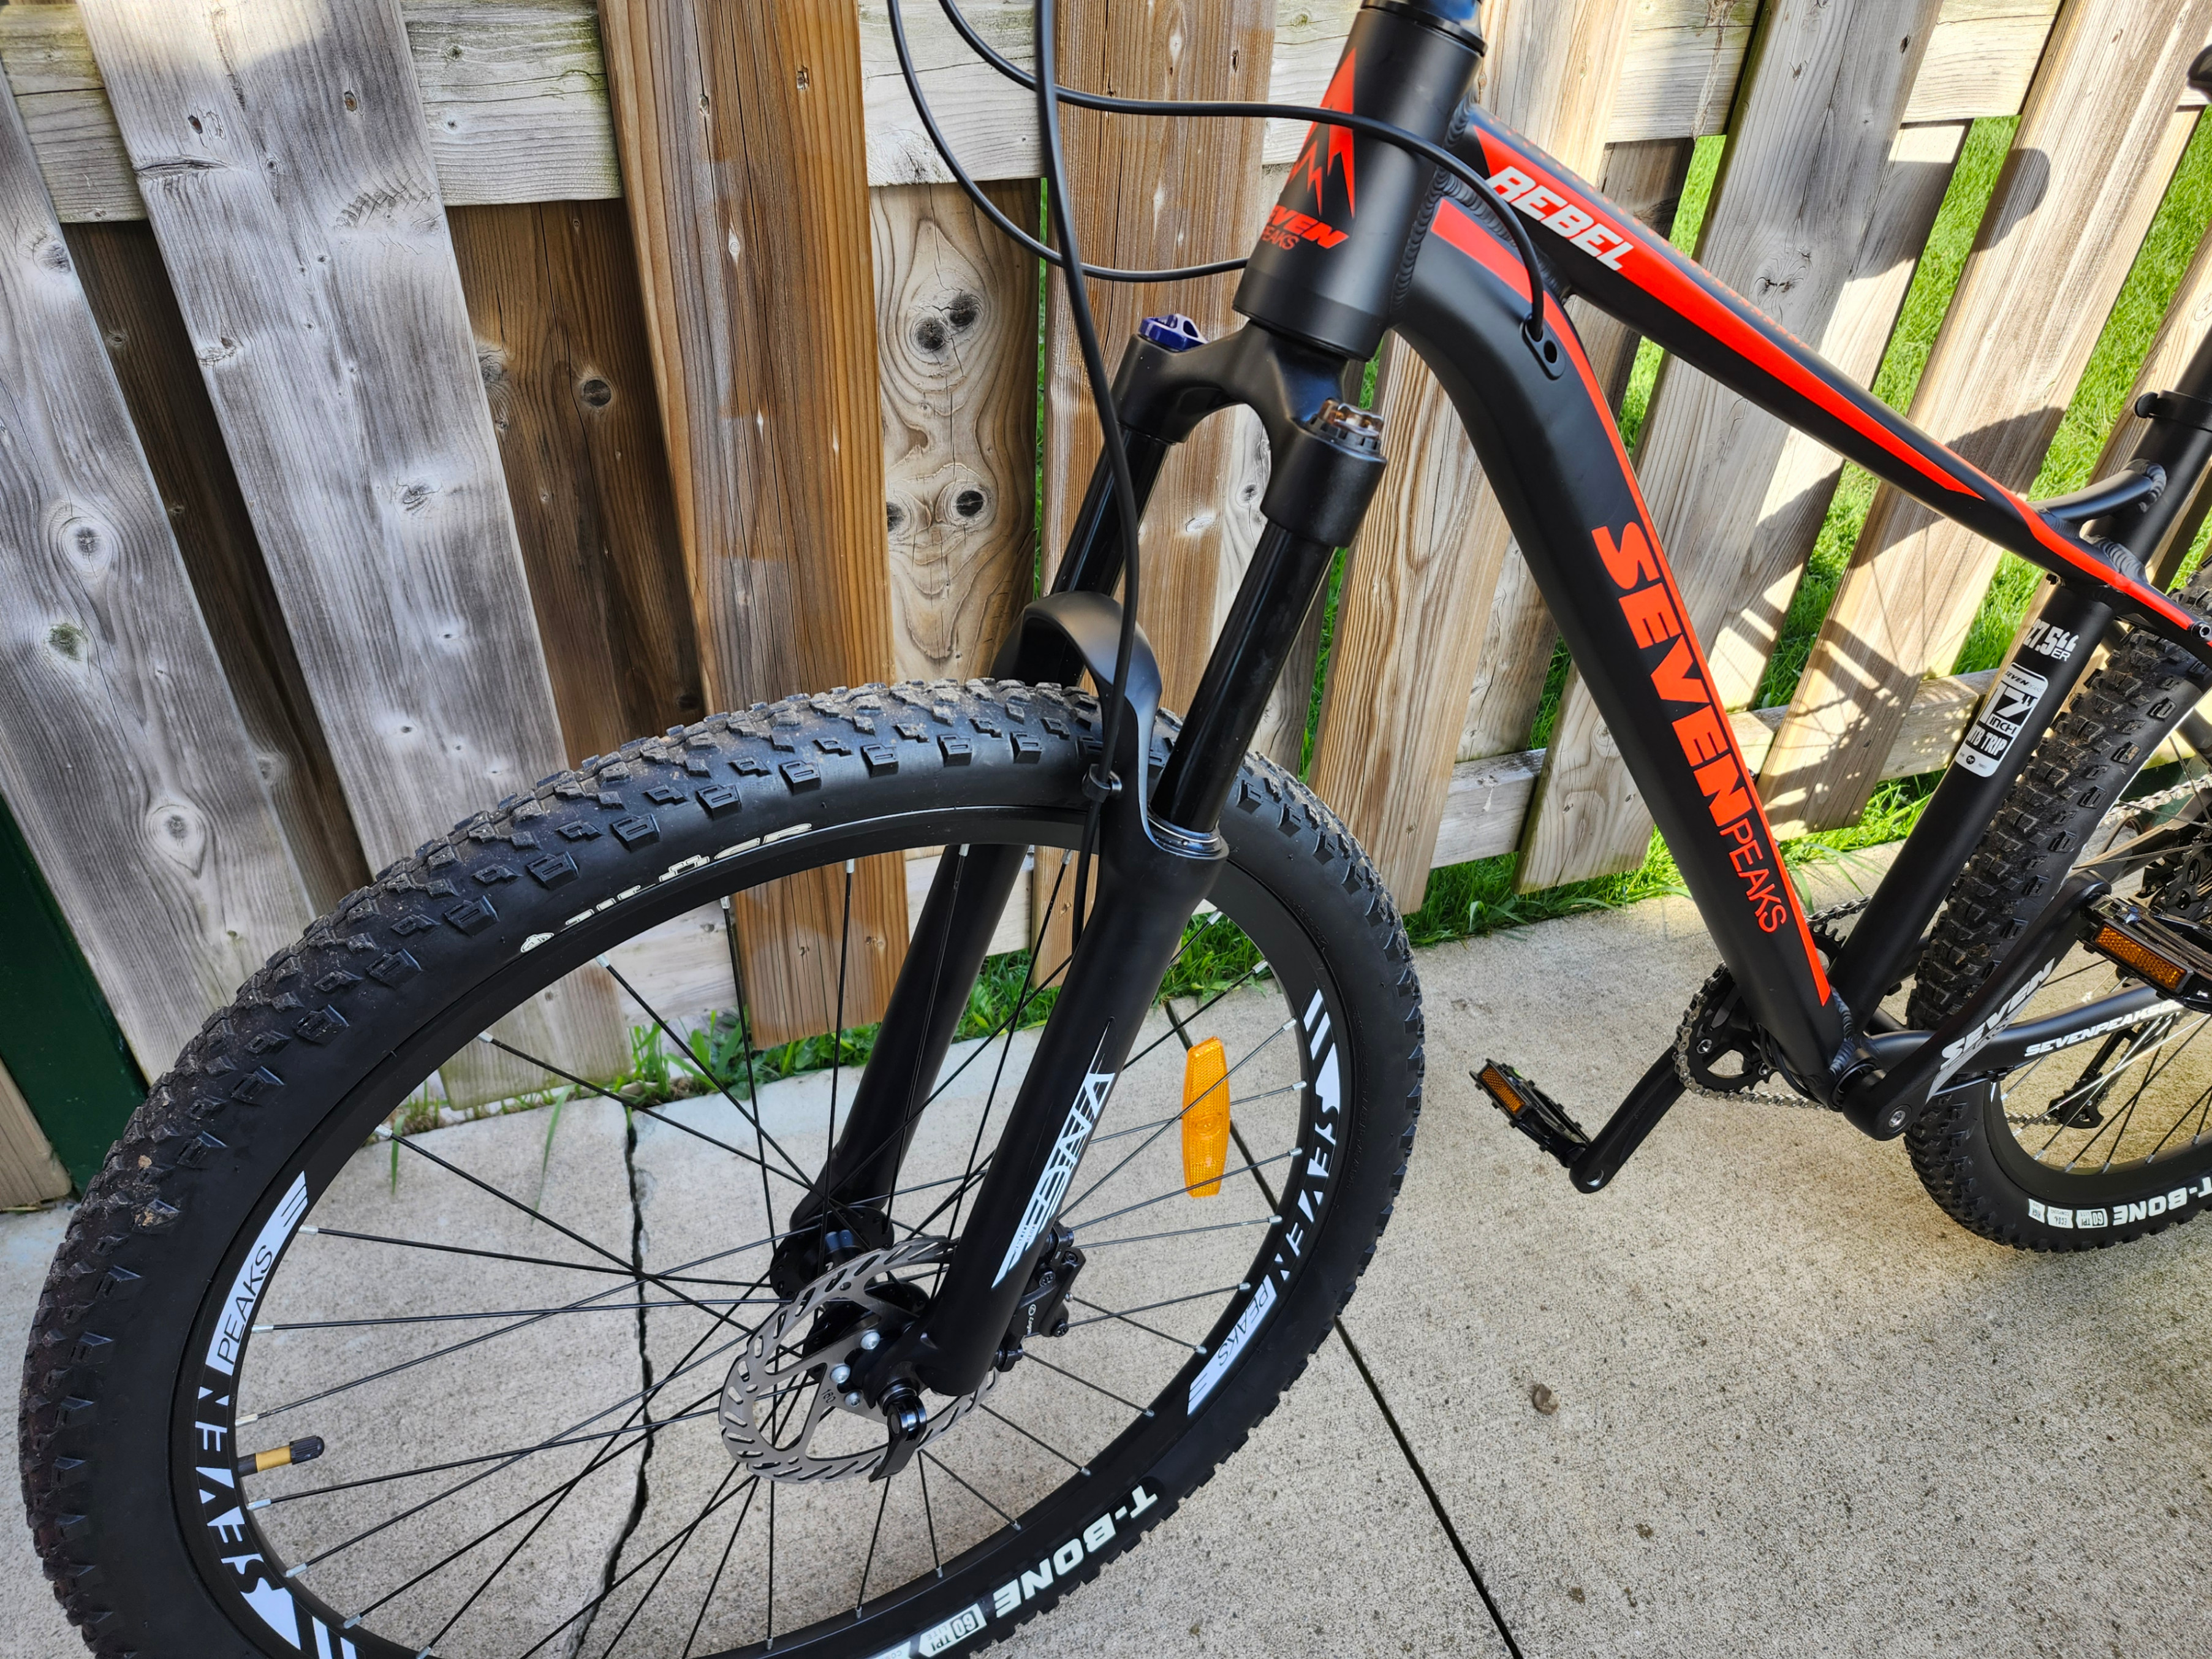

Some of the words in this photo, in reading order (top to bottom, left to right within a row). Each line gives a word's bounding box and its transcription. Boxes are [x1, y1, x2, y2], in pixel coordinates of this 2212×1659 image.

[1485, 165, 1635, 271] REBEL
[2050, 647, 2071, 662] ER
[1591, 521, 1754, 827] SEVEN
[1719, 822, 1787, 933] PEAKS
[1980, 732, 2008, 756] TRIP
[1989, 716, 2018, 735] INCH
[1940, 957, 2056, 1071] SEVEN
[1270, 1103, 1339, 1291] SEVEN
[2112, 1176, 2212, 1226] T-BONE
[2081, 1218, 2091, 1226] TPI
[2092, 1211, 2104, 1226] 60
[218, 1244, 273, 1365] PEAKS
[1218, 1288, 1270, 1367] PEAKS
[821, 1388, 837, 1404] 160
[196, 1365, 285, 1595] SEVEN
[992, 1484, 1159, 1618] T-BONE
[926, 1625, 948, 1641] LITE
[931, 1635, 952, 1652] TPI
[951, 1612, 977, 1638] 60
